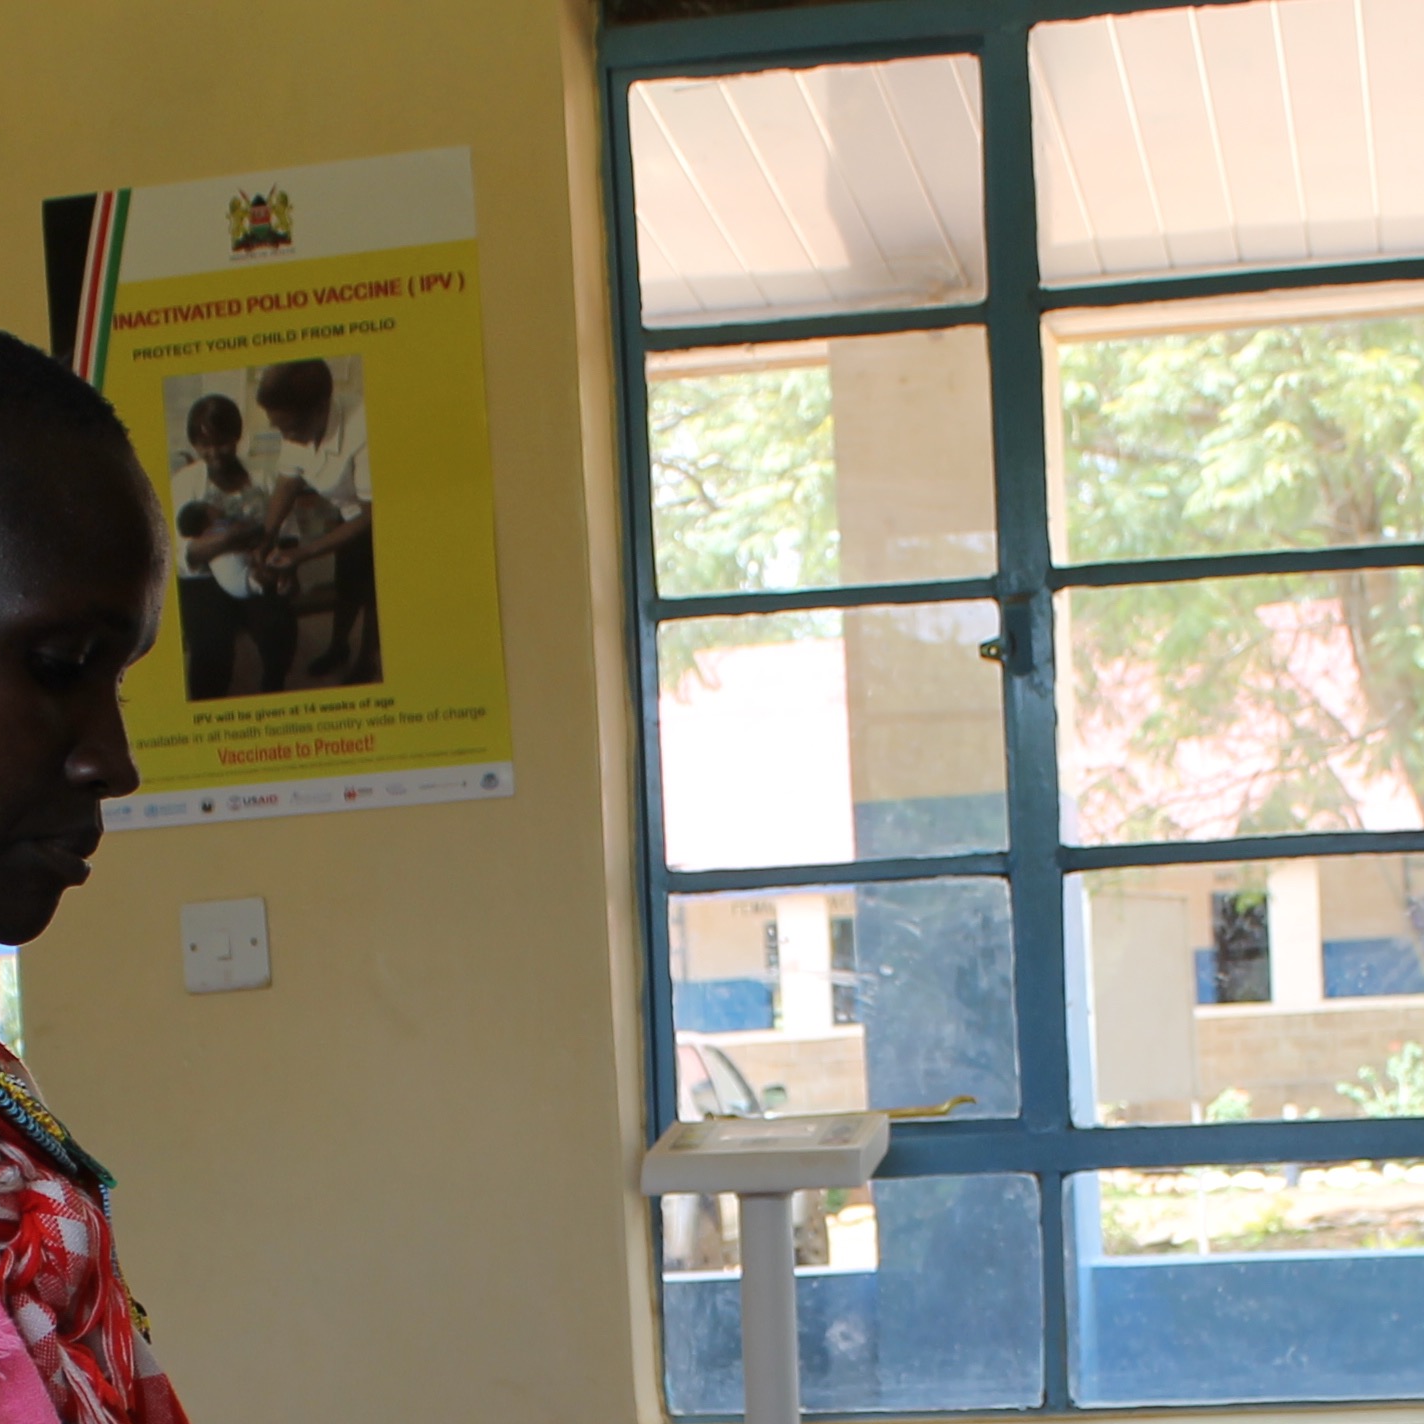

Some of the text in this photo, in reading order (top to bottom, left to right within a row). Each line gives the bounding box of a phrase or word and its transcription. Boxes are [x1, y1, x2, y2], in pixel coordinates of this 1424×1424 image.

[112, 299, 242, 331] INACTIVATED
[246, 290, 308, 313] POLIO
[313, 278, 402, 305] VACCINE
[132, 317, 395, 361] PROTECT YOUR CHILD FROM POLIO
[136, 706, 487, 750] available in all health facilities country wide free of charge
[193, 697, 395, 725] IPV will be given at 14 weeks of age
[217, 744, 291, 766] Vaccinate
[296, 741, 310, 758] to
[314, 734, 374, 757] Protect!
[242, 793, 278, 805] USAID
